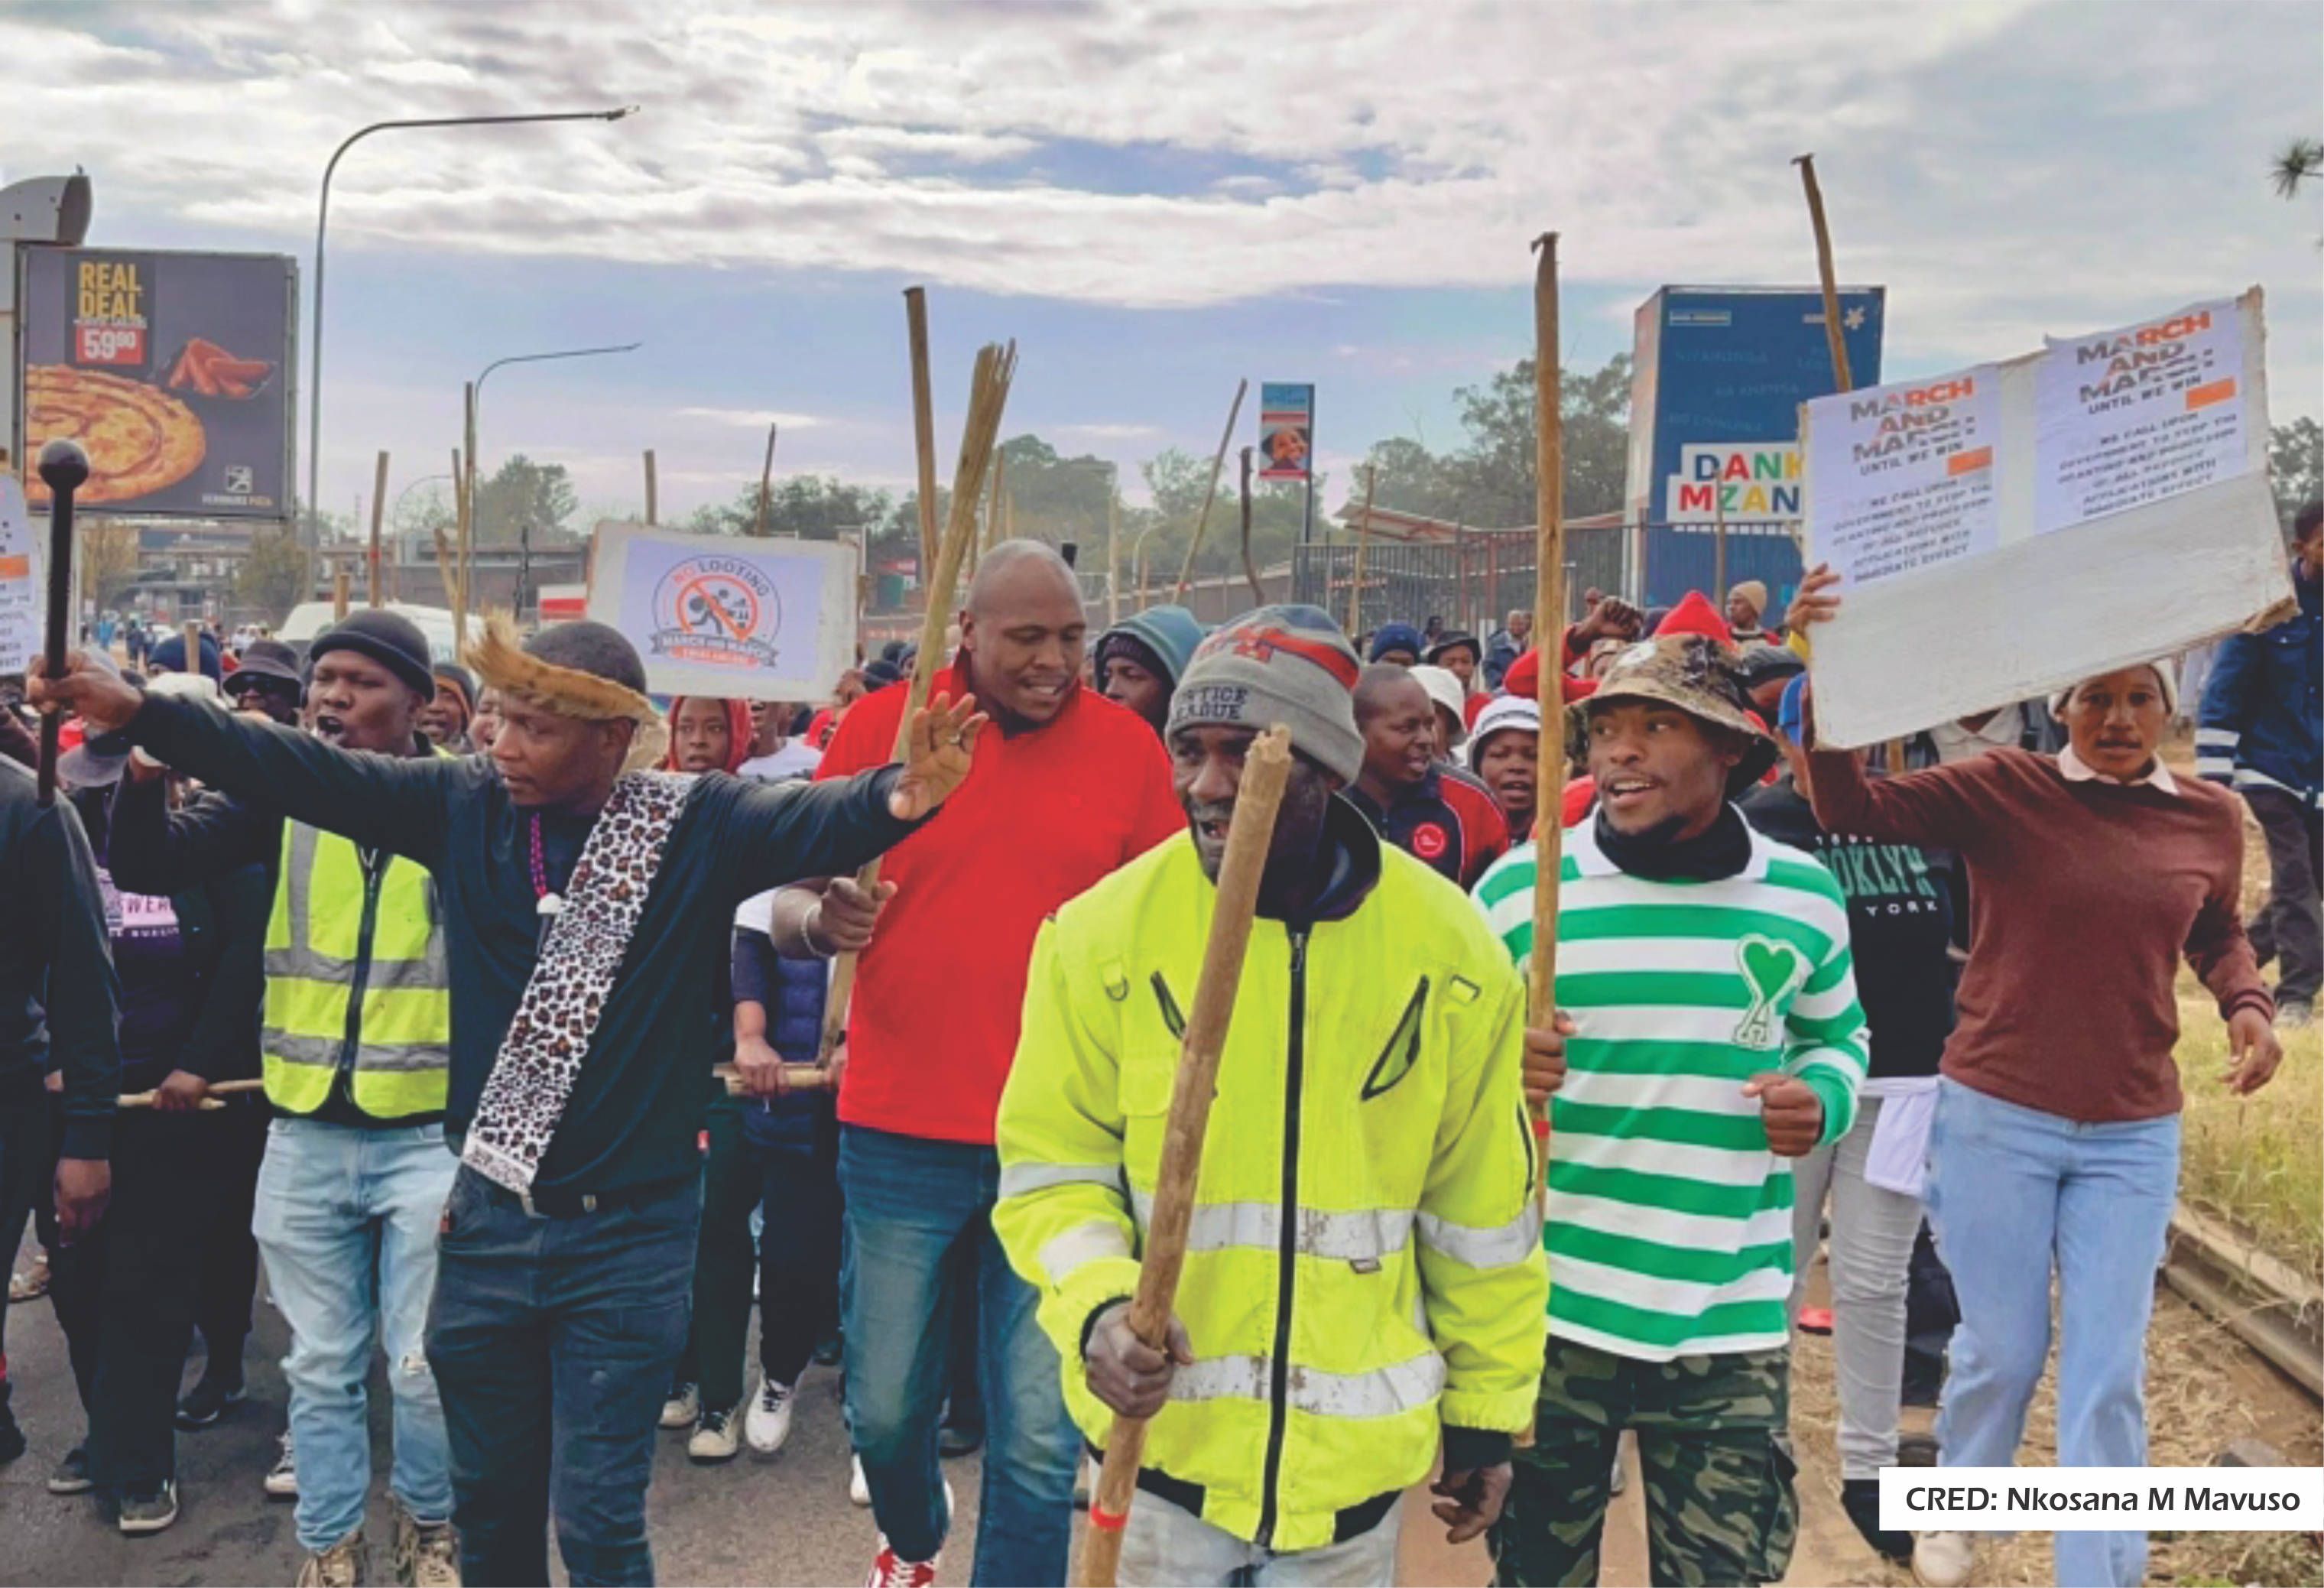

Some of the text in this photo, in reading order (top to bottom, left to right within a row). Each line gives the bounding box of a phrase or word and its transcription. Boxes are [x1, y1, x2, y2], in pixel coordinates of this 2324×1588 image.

[80, 262, 141, 291] REAL
[80, 291, 141, 317] DEAL
[2077, 310, 2212, 365] MARCH
[2107, 343, 2186, 376] AND
[1851, 375, 1973, 421] MARCH
[2088, 396, 2135, 415] UNTIL
[1879, 405, 1949, 435] AND
[1860, 457, 1902, 476] UNTIL
[1678, 484, 1800, 514] MZAN
